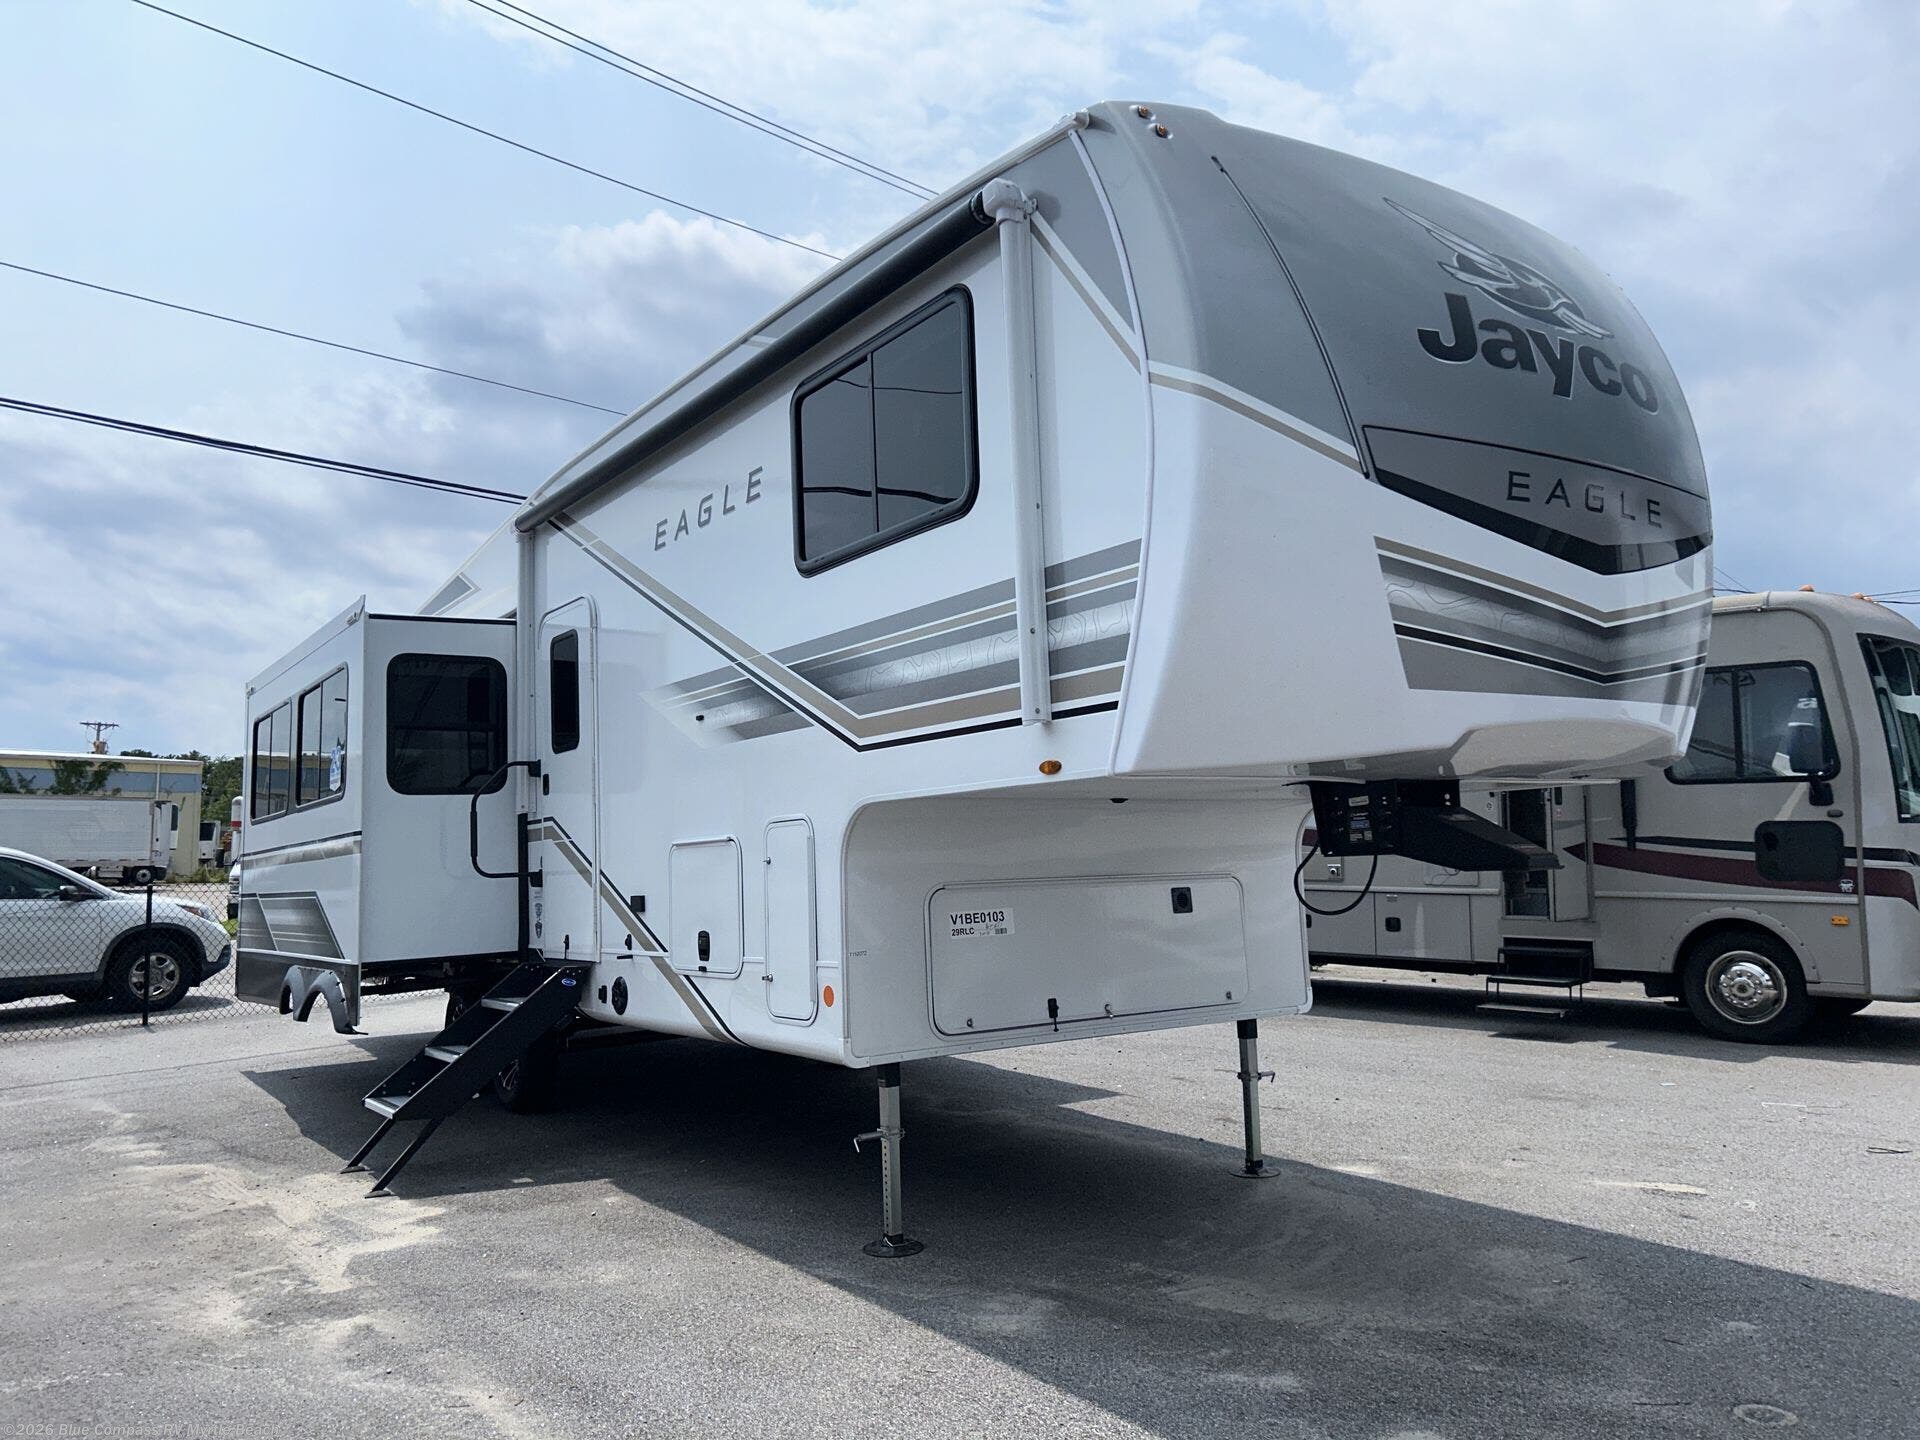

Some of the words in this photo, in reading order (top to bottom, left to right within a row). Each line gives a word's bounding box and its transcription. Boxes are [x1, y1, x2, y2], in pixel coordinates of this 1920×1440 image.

[1417, 292, 1659, 415] Jayco
[654, 466, 763, 551] EAGLE
[1506, 471, 1663, 528] EAGLE
[950, 911, 1005, 925] V1BE0103
[951, 927, 975, 936] 29RLC
